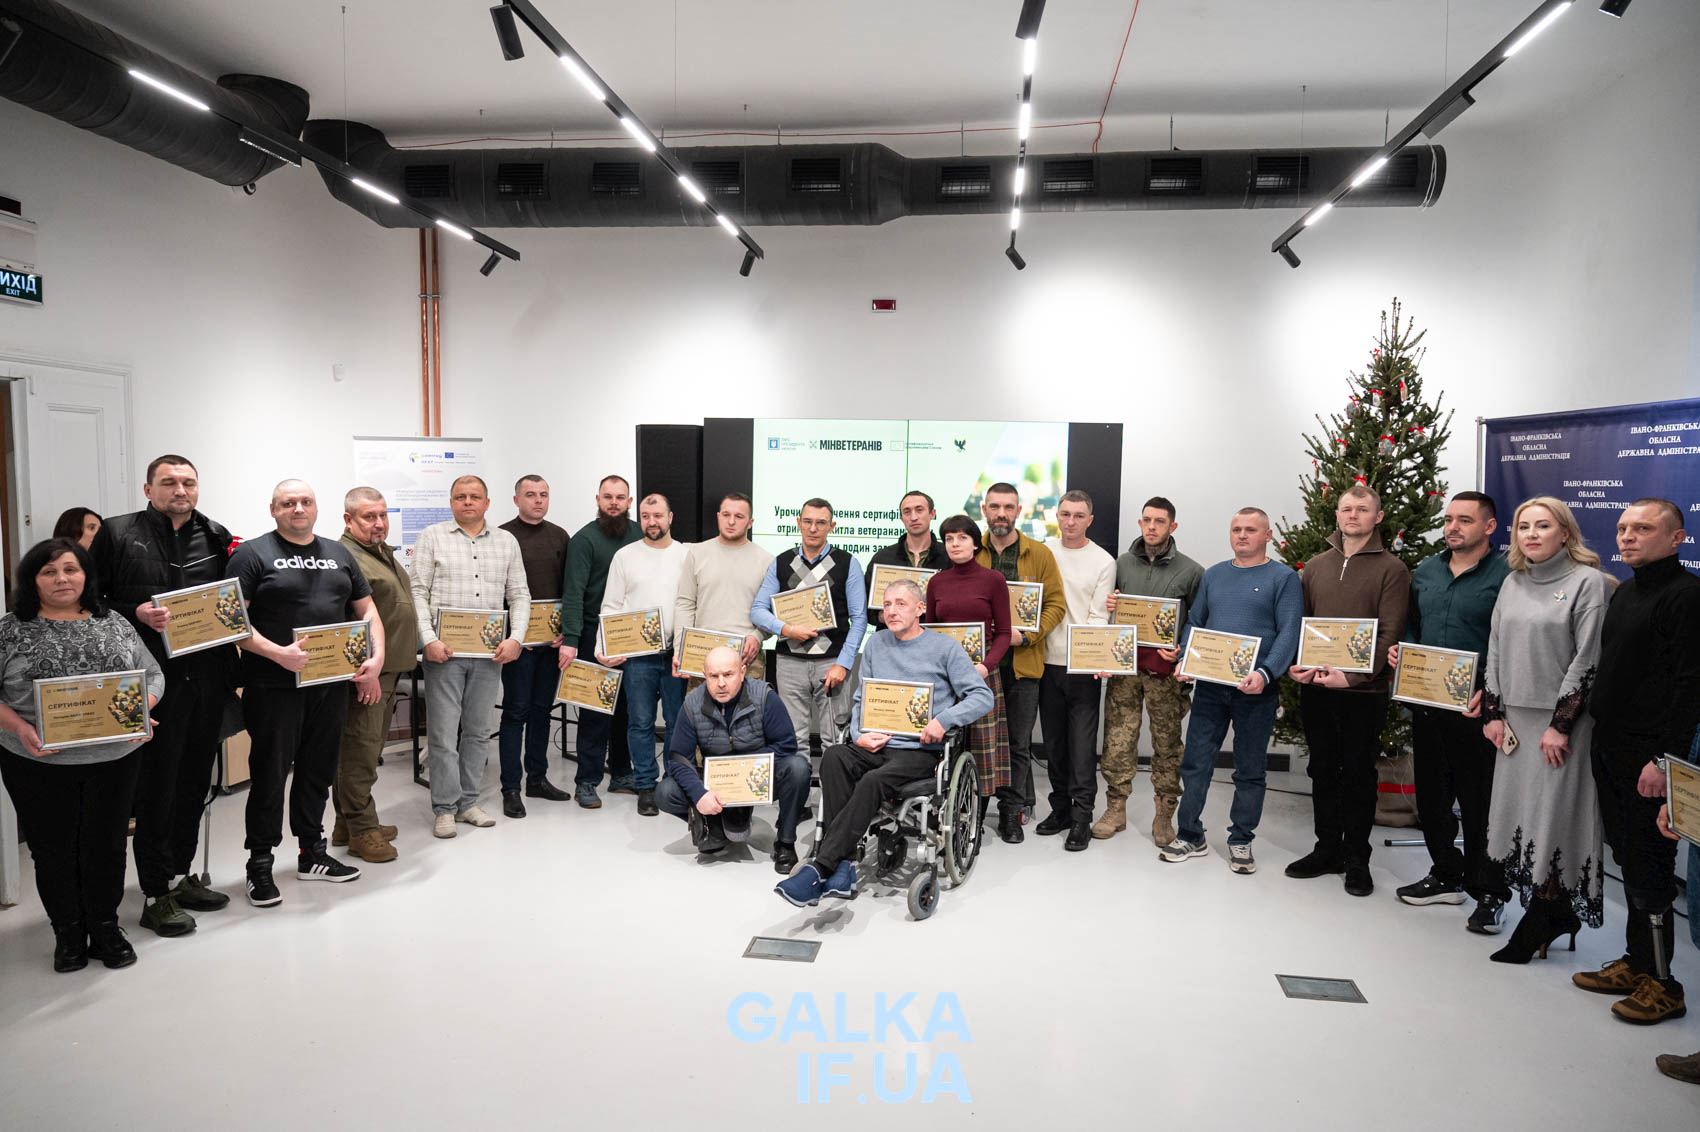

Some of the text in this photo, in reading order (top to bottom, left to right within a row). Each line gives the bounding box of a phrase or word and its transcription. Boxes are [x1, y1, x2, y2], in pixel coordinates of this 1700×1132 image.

[0, 271, 37, 295] ИХІД
[6, 287, 20, 296] EXIT
[1510, 432, 1562, 442] ІВАНО-ФРАНКІВСЬКА
[1648, 436, 1681, 444] ОБЛАСНА
[819, 439, 883, 451] МІНВЕТЕРАНІВ
[1522, 443, 1548, 451] ОБЛАСНА
[1500, 452, 1571, 462] ДЕРЖАВНА АДМІНІСТРАЦІЯ
[1617, 446, 1700, 458] ДЕРЖАВНА АДМІНІСТРА
[774, 506, 899, 522] Урочи чення сертифі
[273, 555, 338, 569] adidas
[169, 608, 205, 621] ЕРТИФІКАТ
[47, 699, 97, 710] СЕРТИФІКАТ
